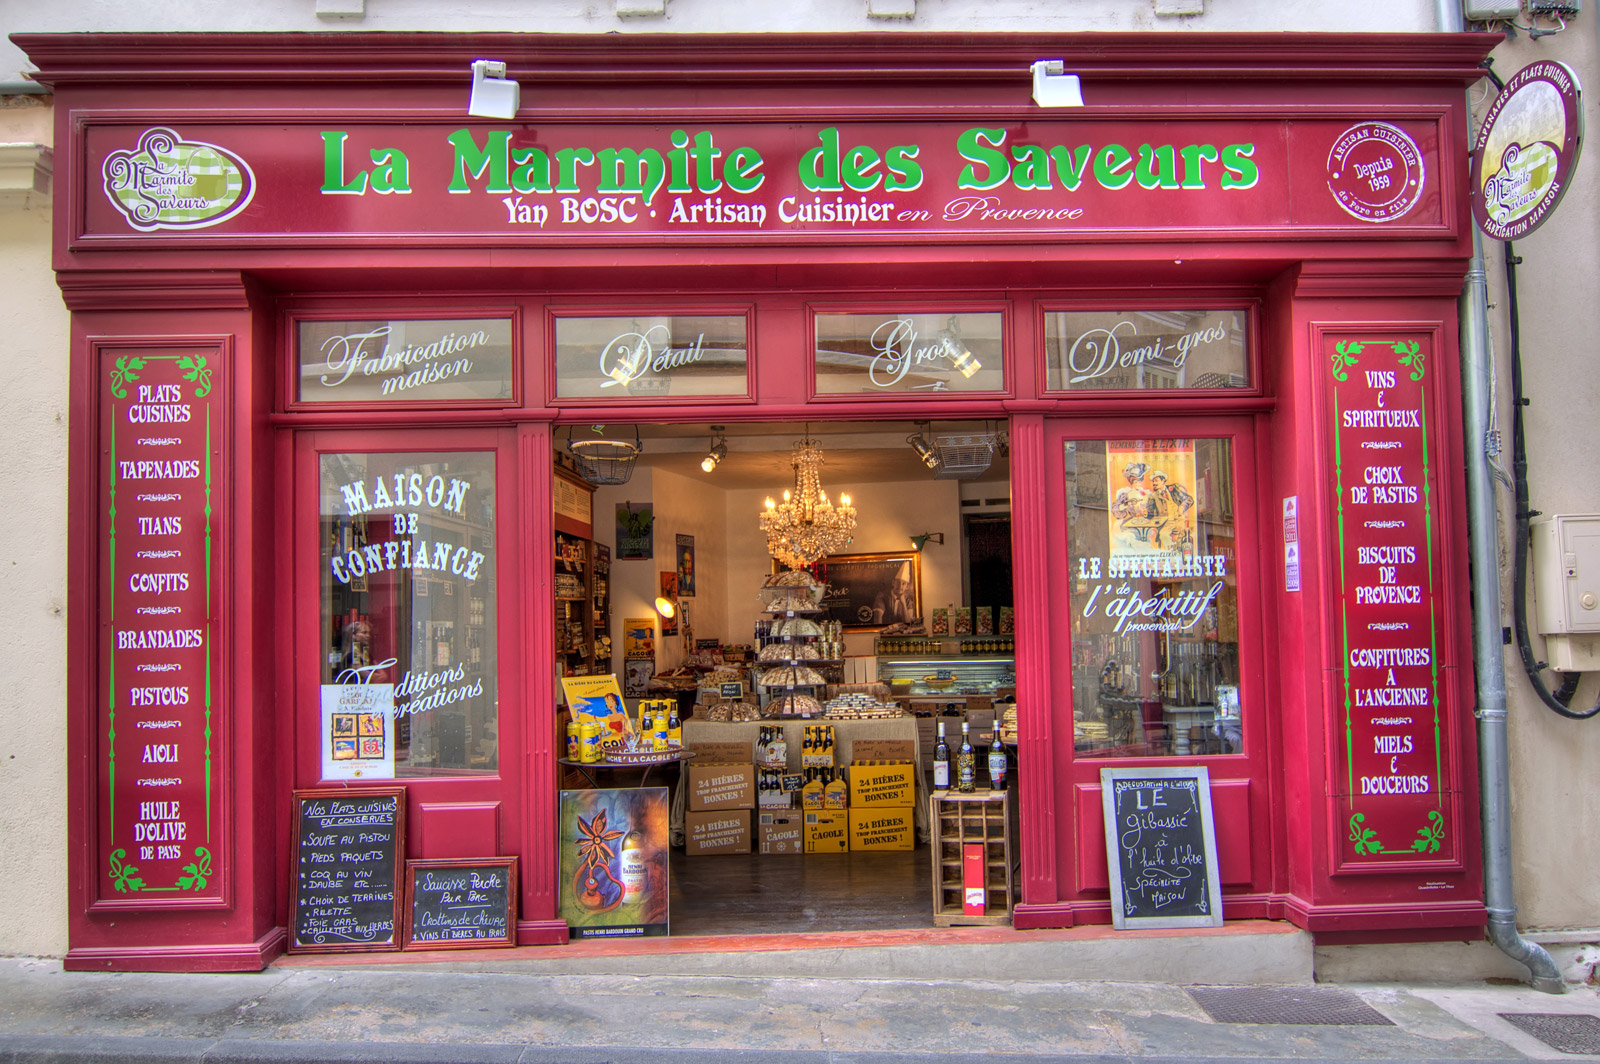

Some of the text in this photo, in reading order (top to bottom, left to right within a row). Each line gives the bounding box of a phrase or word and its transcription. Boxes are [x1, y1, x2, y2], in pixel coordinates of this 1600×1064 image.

[1477, 90, 1509, 150] TAPENADES
[1510, 76, 1520, 91] ET
[1520, 64, 1543, 83] PLATS
[1334, 129, 1416, 166] ARTISAN CUISINIER
[111, 158, 196, 189] Marmite
[320, 127, 1259, 205] La Marmite des Saveurs
[1353, 156, 1394, 179] Depuis
[156, 184, 172, 195] des
[1368, 175, 1391, 191] 1959
[134, 185, 209, 221] Saveurs
[502, 196, 1084, 228] Yan BOSC Artisan Cuisinier en Provence
[1483, 180, 1560, 238] FABRICATION MAISON
[319, 326, 489, 387] Fabrication
[600, 324, 705, 388] Détail
[869, 317, 951, 387] Gros
[1069, 320, 1226, 384] Demi-gros
[381, 355, 473, 395] maison
[1365, 371, 1396, 389] VINS
[138, 385, 181, 403] PLATS
[128, 404, 191, 423] CUISINES
[1343, 410, 1420, 428] SPIRITUEUX
[1152, 439, 1190, 449] ELIXIR
[120, 460, 200, 479] TAPENADES
[1364, 466, 1403, 485] CHOIX
[340, 473, 470, 517] MAISON
[1351, 485, 1418, 505] DE PASTIS
[138, 517, 182, 535] TIANS
[394, 513, 419, 535] DE
[331, 540, 485, 584] CONFIANCE
[1357, 546, 1416, 565] BISCUITS
[1079, 555, 1227, 579] LE SPECIALISTE
[1379, 566, 1396, 584] DE
[130, 572, 189, 595] CONFITS
[1116, 582, 1131, 595] de
[1356, 586, 1421, 604] PROVENCE
[1083, 581, 1223, 632] l'apéritif
[1121, 618, 1182, 637] provençal
[117, 629, 203, 649] BRANDADES
[1350, 647, 1430, 669] CONFITURES
[1386, 668, 1397, 686] A
[130, 686, 189, 706] PISTOUS
[1355, 687, 1428, 707] L'ANCIENNE
[142, 744, 179, 763] AIOLI
[1374, 735, 1413, 754] MIELS
[640, 754, 670, 763] CAGOLE
[698, 773, 744, 788] 24 BIÈRES
[711, 783, 749, 794] FRANCHEMENT
[872, 774, 904, 786] BIÈRES
[872, 783, 909, 793] FRANCHEMENT
[1360, 775, 1429, 795] DOUCEURS
[703, 792, 739, 804] BONNES
[864, 792, 899, 803] BONNES
[1136, 789, 1168, 810] LE
[140, 801, 180, 821] HUILE
[330, 801, 355, 815] PLATS
[321, 814, 393, 826] EN CONSERVES
[694, 819, 740, 833] 24 BIÈRES
[858, 817, 904, 830] 24 BIÈRES
[135, 821, 187, 842] D'OLIVE
[307, 832, 338, 847] SOUPE
[341, 835, 354, 845] AU
[707, 828, 745, 839] FRANCHEMENT
[766, 830, 799, 841] CAGOLE
[812, 830, 844, 841] CAGOLE
[870, 826, 908, 836] FRANCHEMENT
[1154, 833, 1168, 847] à
[700, 837, 735, 849] BONNES
[863, 835, 898, 846] BONNES
[140, 845, 181, 861] DE PAYS
[341, 851, 384, 864] PAQUETS
[310, 870, 330, 880] COQ
[336, 870, 348, 879] AU
[308, 880, 343, 889] DAUBE
[337, 896, 349, 904] DE
[334, 917, 359, 926] GRAS
[458, 911, 470, 925] de
[442, 929, 451, 939] ET
[476, 930, 485, 938] AU
